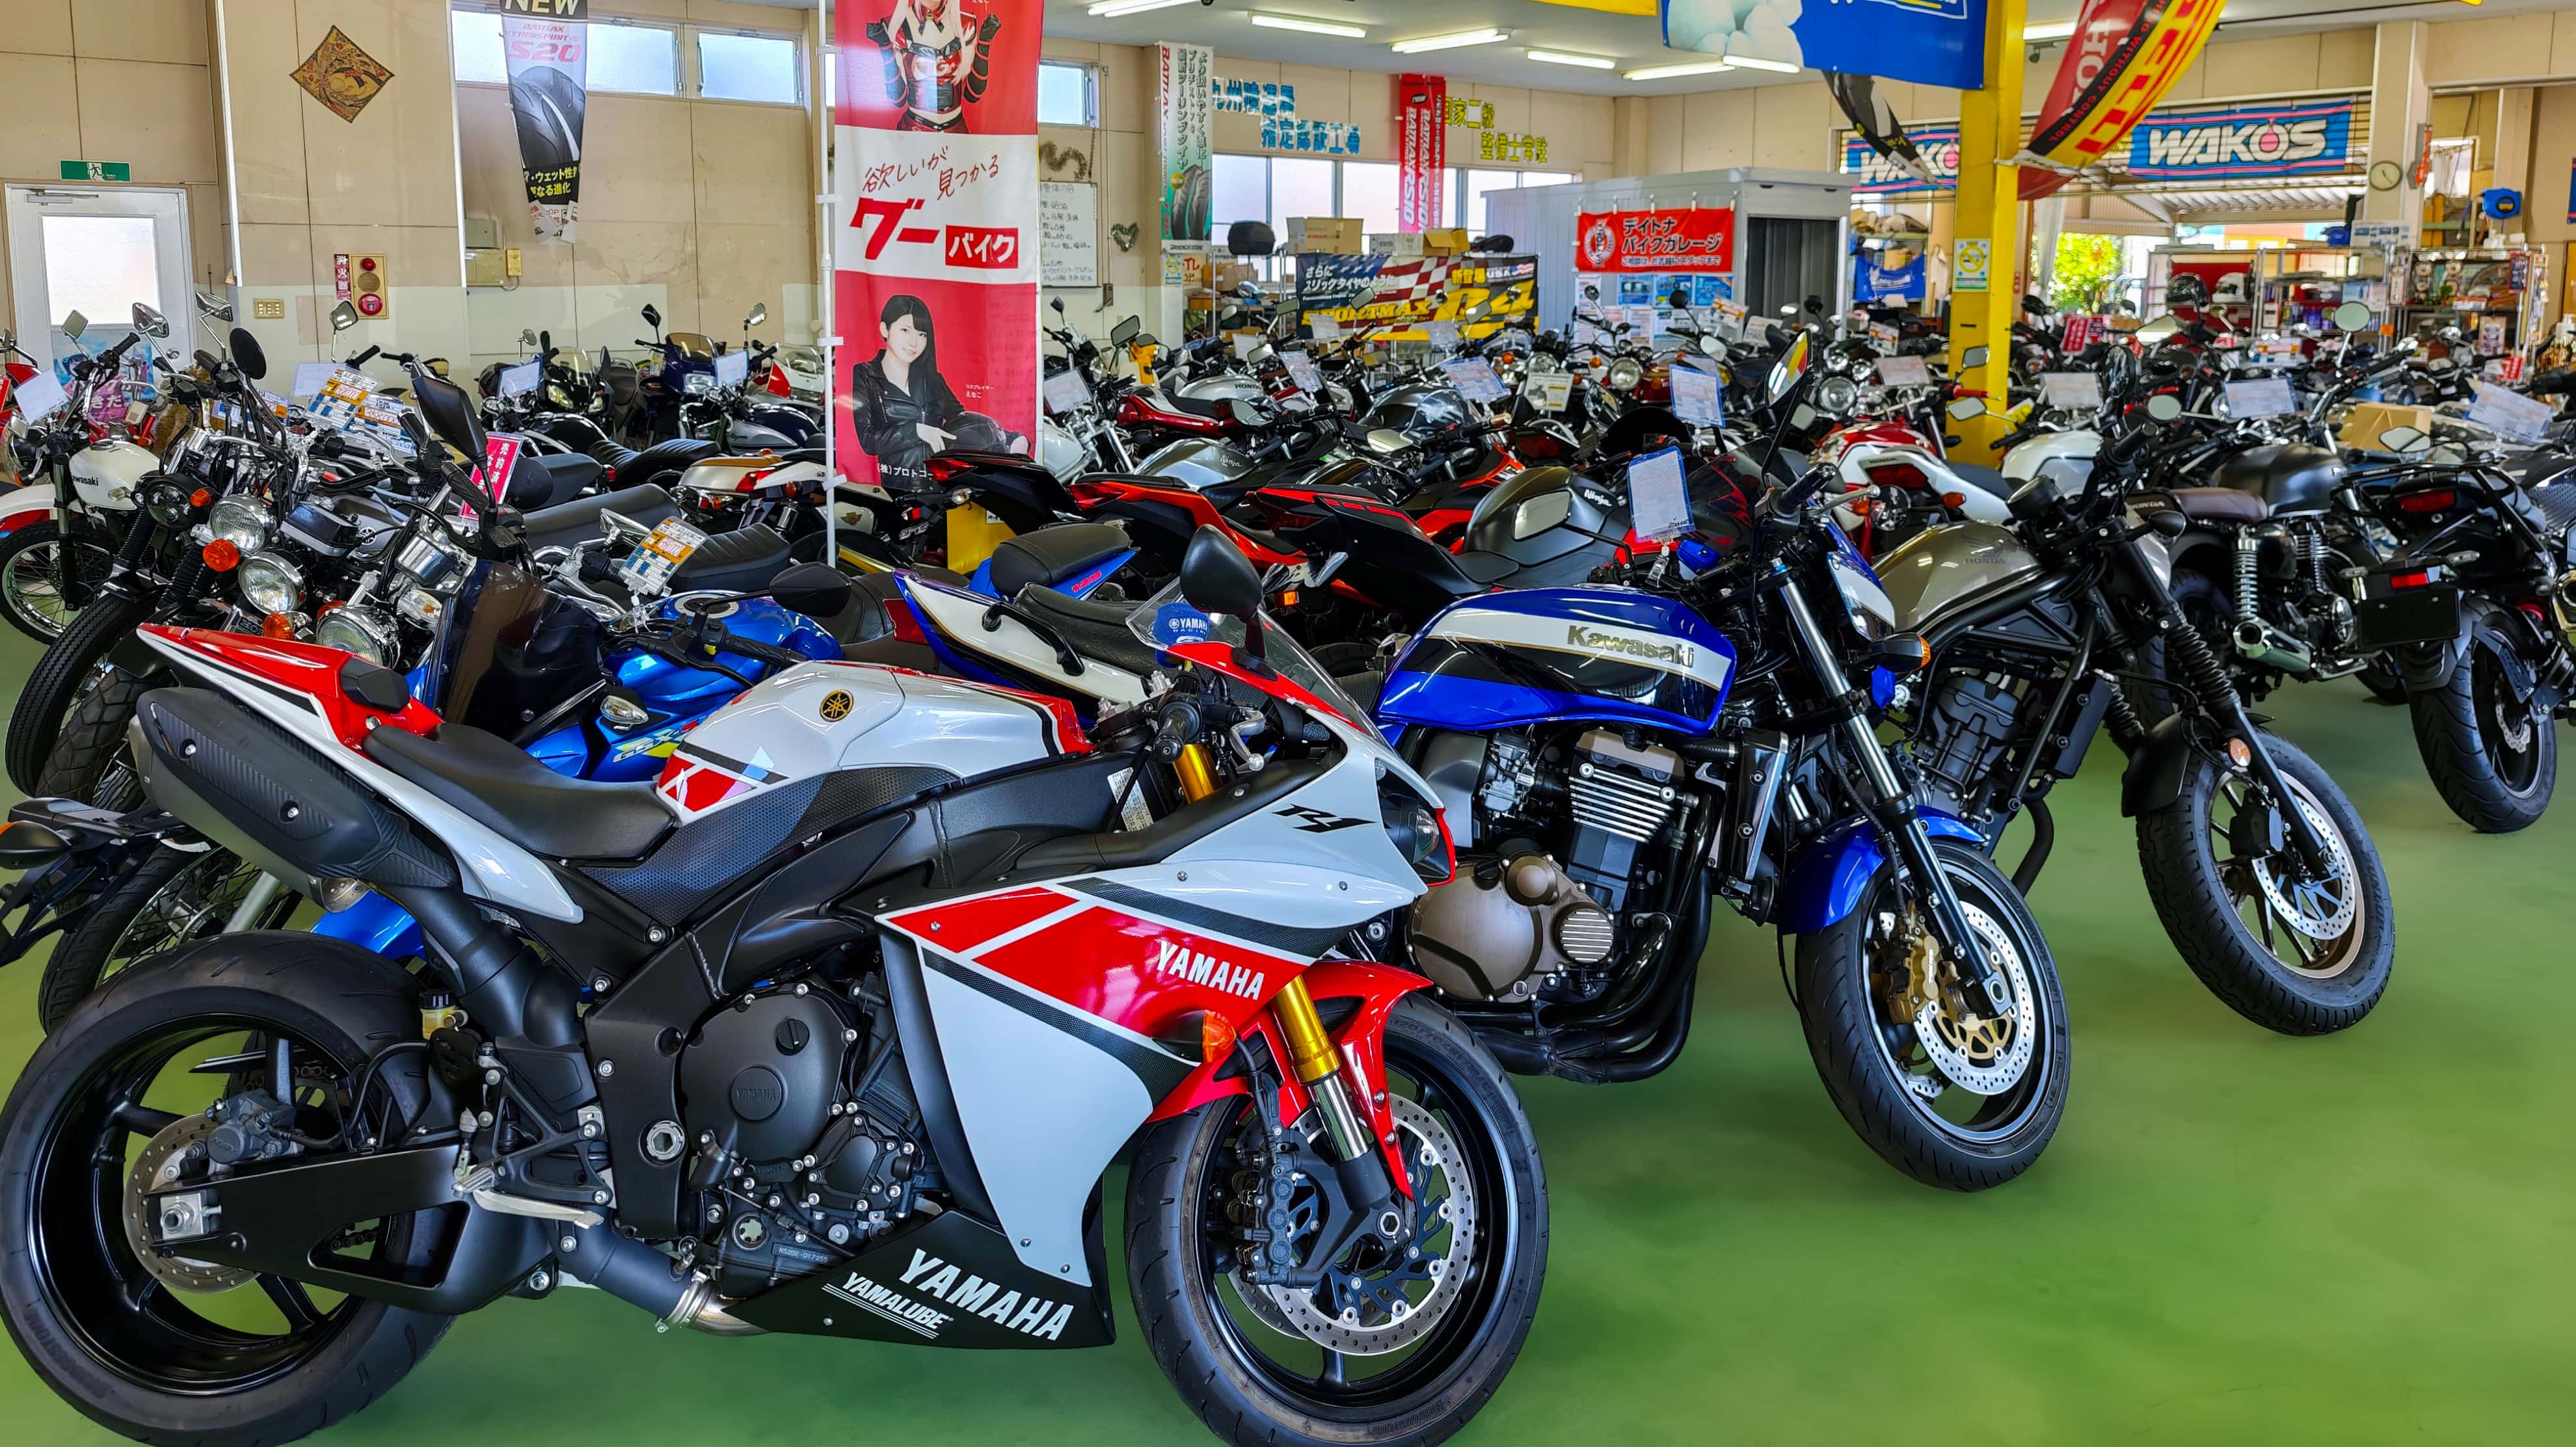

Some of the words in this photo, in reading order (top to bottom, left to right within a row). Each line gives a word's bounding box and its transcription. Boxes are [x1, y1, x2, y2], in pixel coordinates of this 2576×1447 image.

[505, 0, 578, 16] NEW
[507, 40, 582, 62] S20
[2099, 36, 2141, 92] WITHOUT
[2048, 94, 2097, 142] CONTROL
[2149, 118, 2327, 166] WAKO'S
[862, 146, 949, 193] 欲しいが
[937, 153, 1000, 200] 見つかる
[1621, 233, 1723, 254] バイクガレージ
[1624, 218, 1676, 235] デイトナ
[947, 232, 1017, 264] バイク
[336, 254, 349, 291] 消火器
[1303, 274, 1395, 292] スリックタイヤのように
[1306, 265, 1334, 278] さらに
[965, 390, 982, 399] えなこ
[1219, 454, 1242, 468] Ninja
[1583, 488, 1613, 507] Ninja
[1566, 624, 1695, 669] Kawasaki
[1156, 940, 1265, 1000] YAMAHA
[841, 1271, 948, 1329] YAMALUBE
[898, 1248, 1074, 1341] YAMAHA
